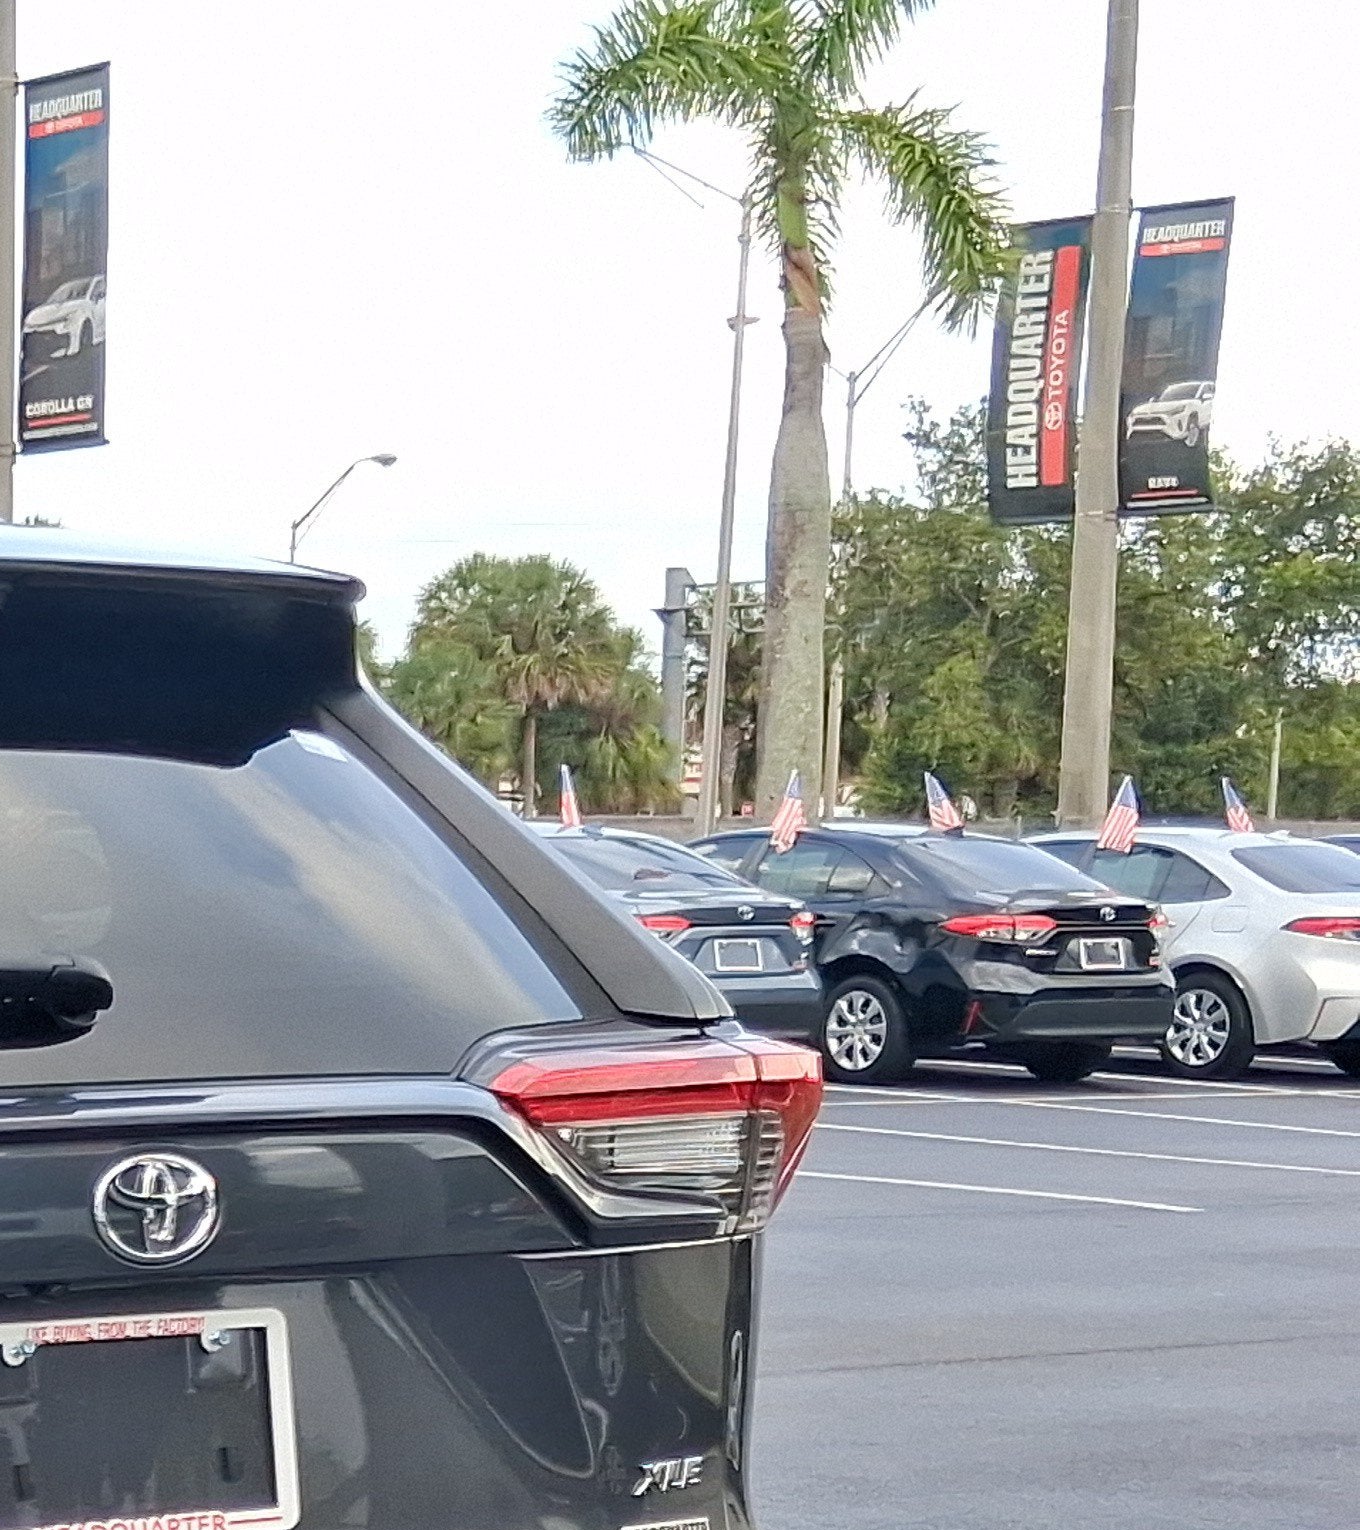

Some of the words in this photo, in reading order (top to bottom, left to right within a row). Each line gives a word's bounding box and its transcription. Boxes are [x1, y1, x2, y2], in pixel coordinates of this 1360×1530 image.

[1006, 249, 1055, 489] HEADQUARTER
[1048, 309, 1070, 400] TOYOTA
[630, 1456, 704, 1497] XLE
